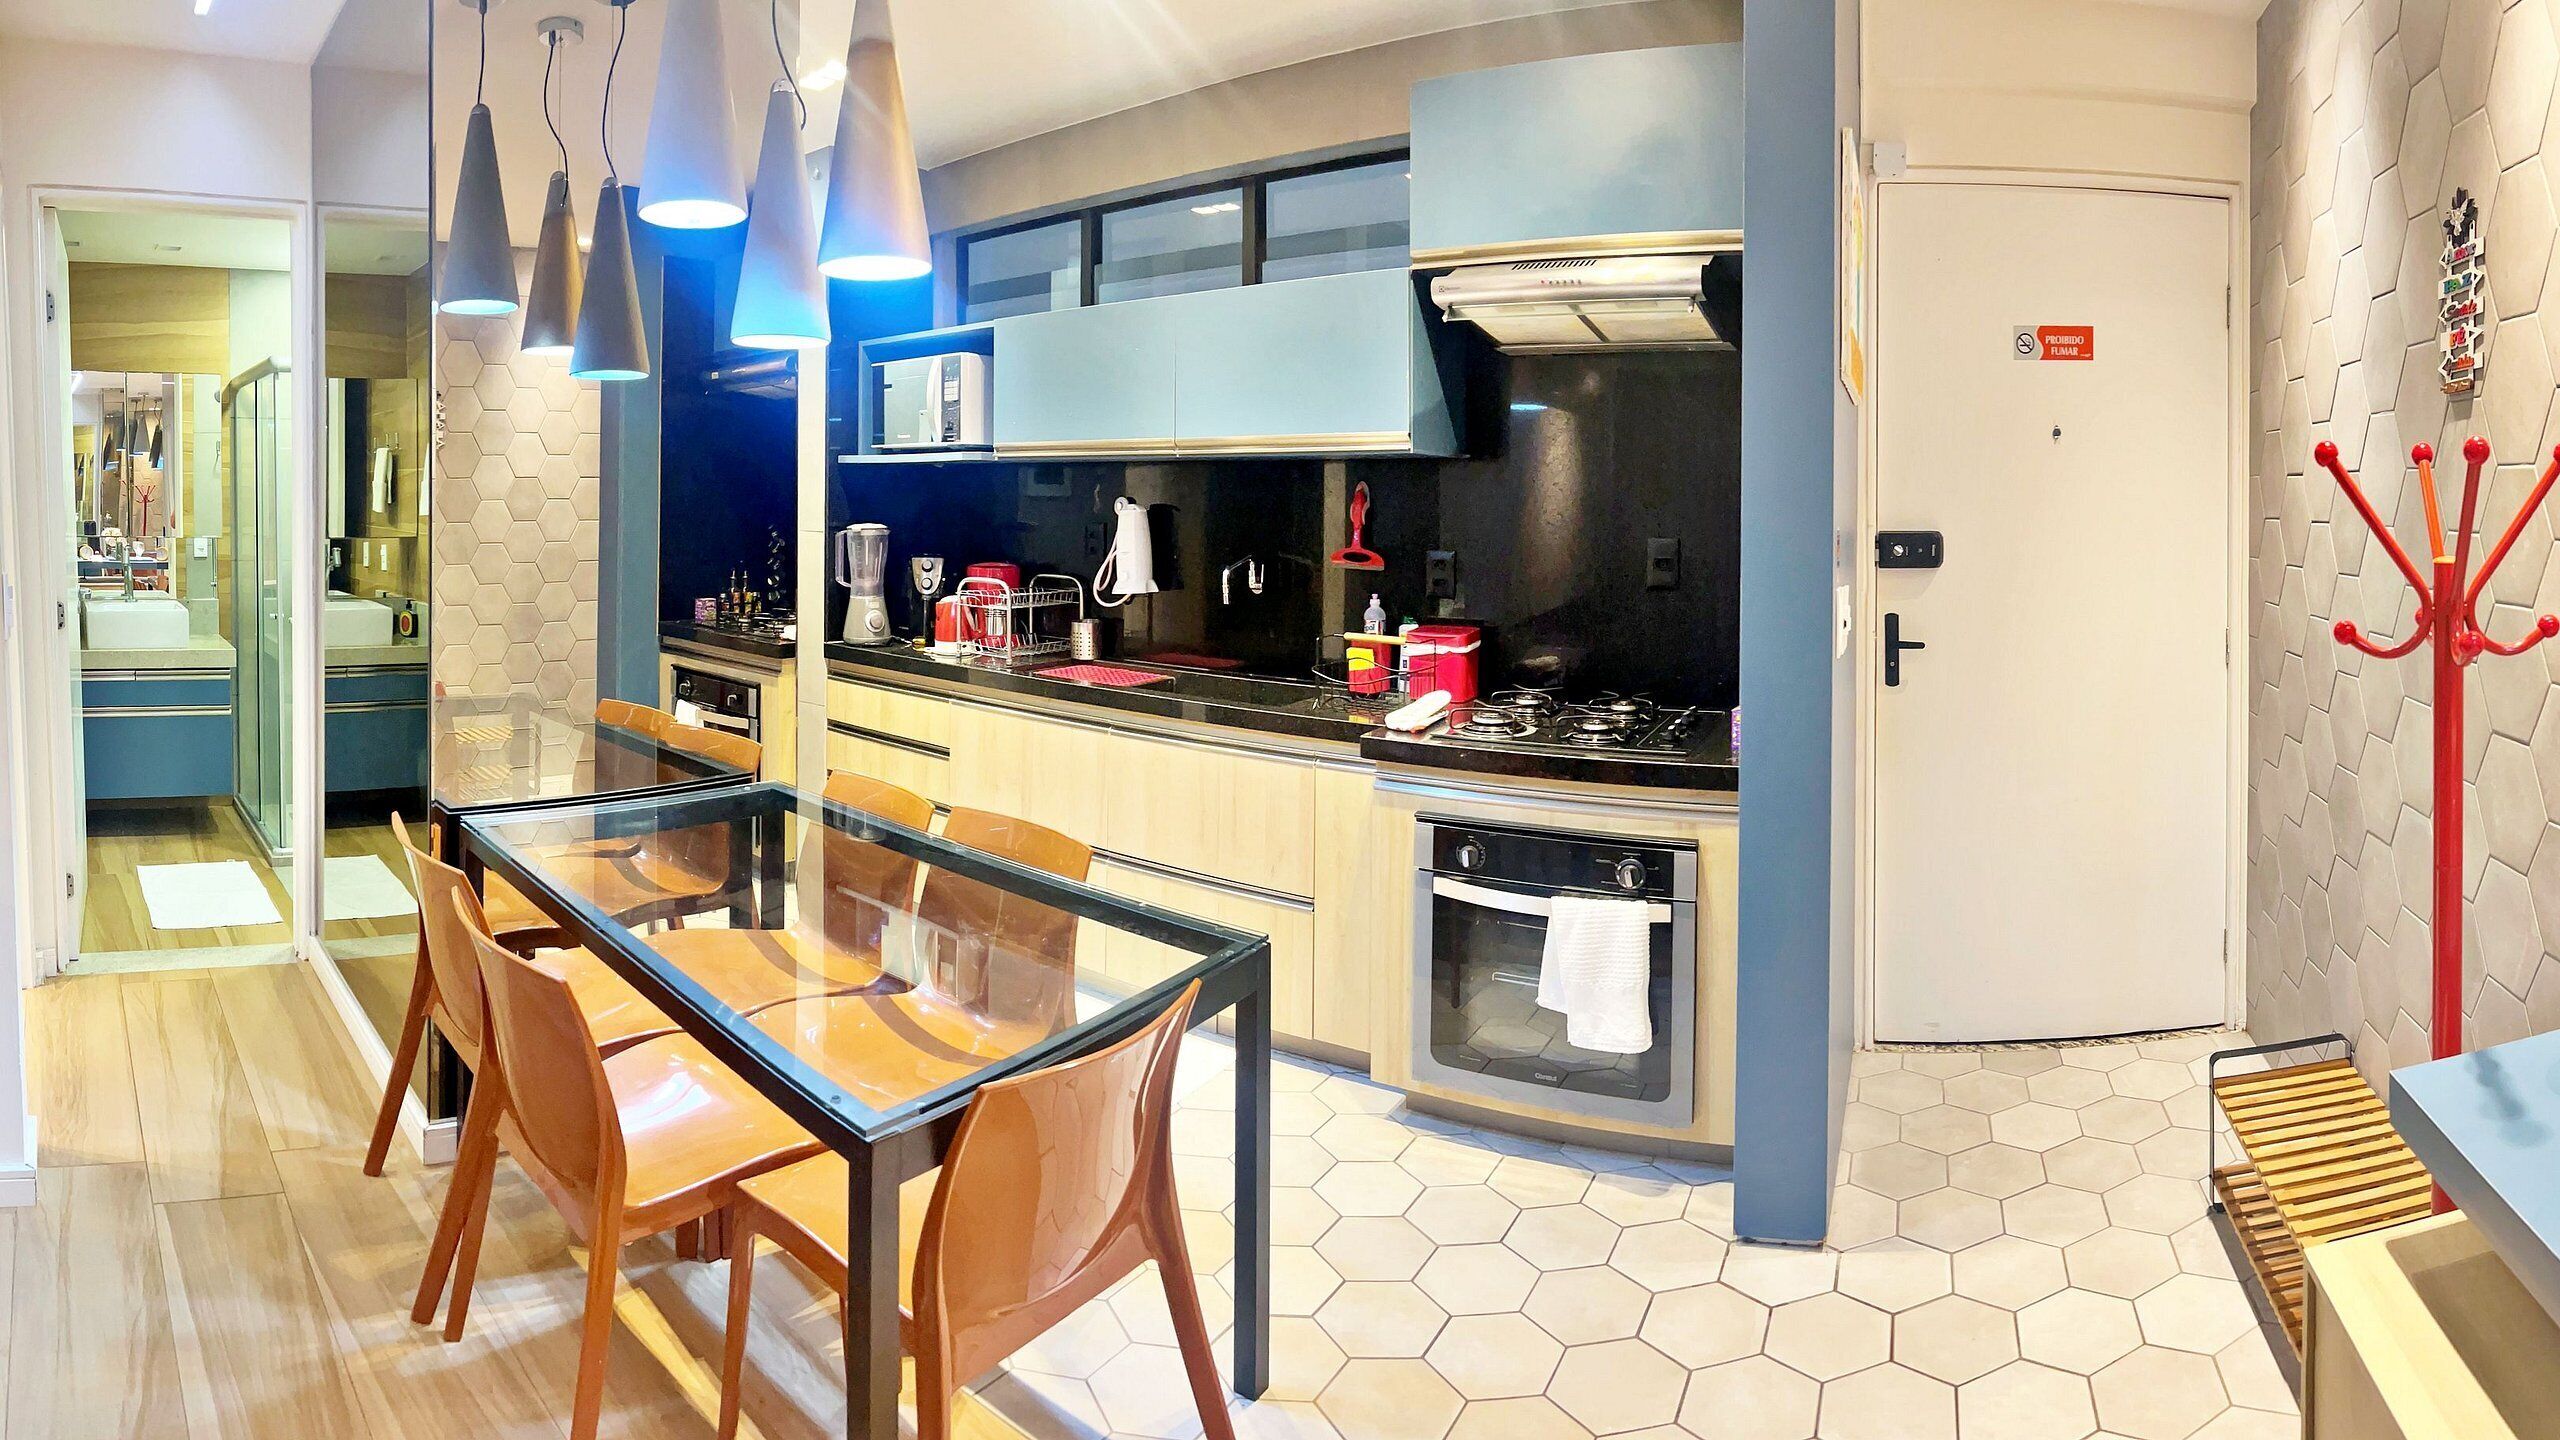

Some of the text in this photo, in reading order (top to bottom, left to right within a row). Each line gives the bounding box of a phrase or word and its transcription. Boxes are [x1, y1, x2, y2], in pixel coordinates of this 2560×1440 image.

[2443, 272, 2472, 294] PAZ
[2045, 335, 2084, 344] PROIBIDO
[2051, 347, 2078, 356] FUMAR
